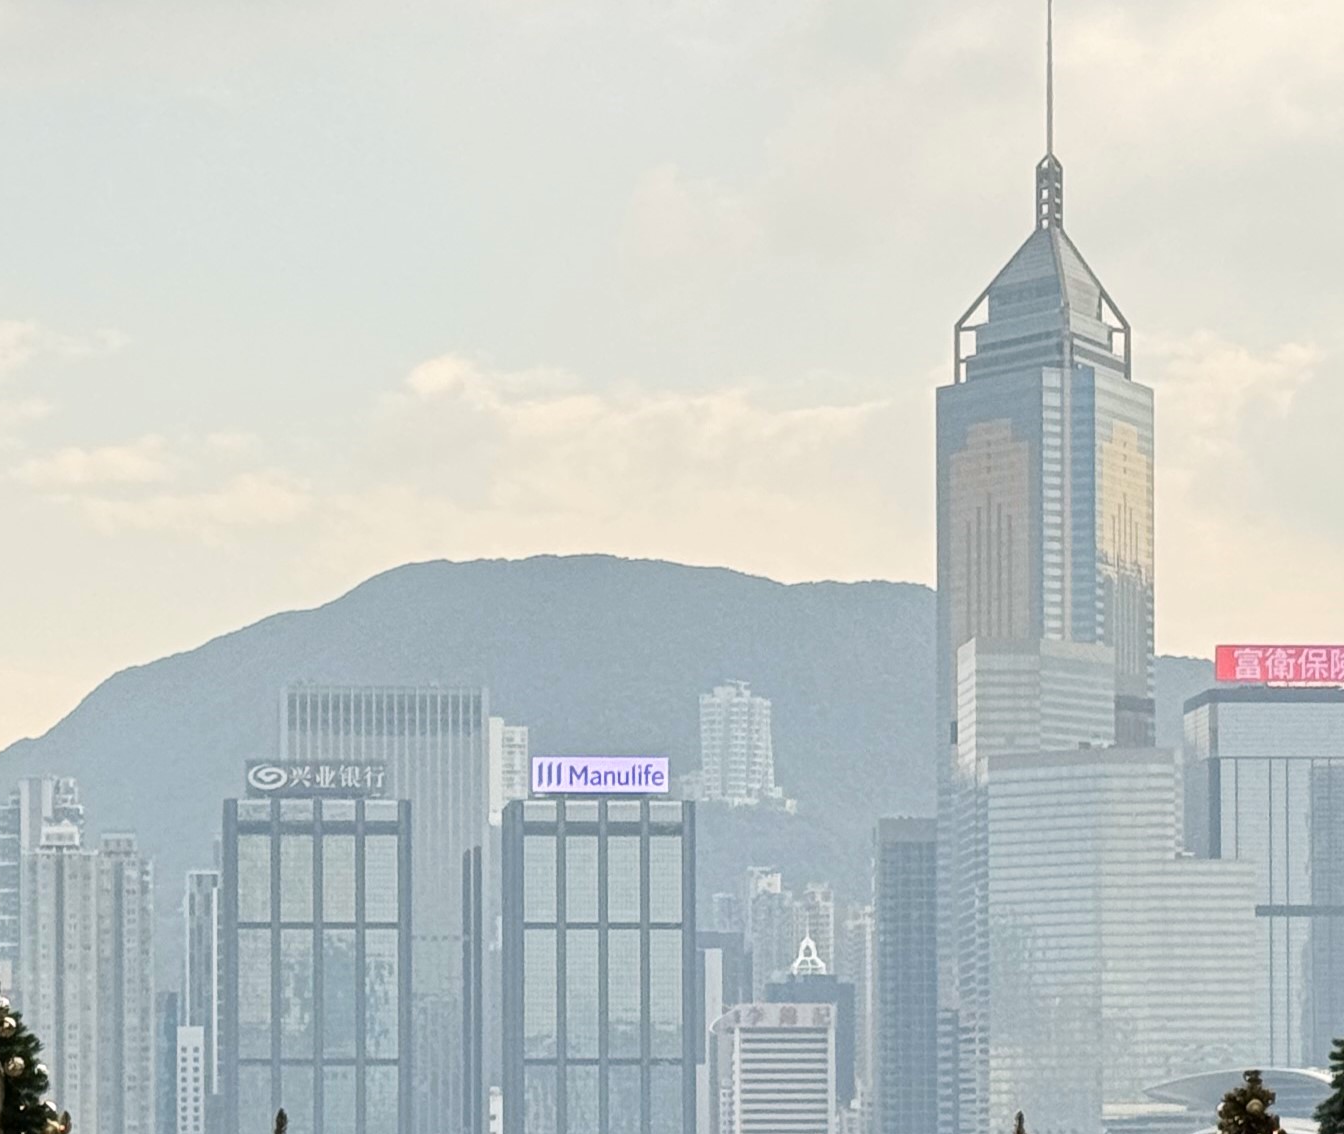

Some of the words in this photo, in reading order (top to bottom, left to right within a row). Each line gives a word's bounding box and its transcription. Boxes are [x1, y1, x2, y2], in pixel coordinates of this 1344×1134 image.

[289, 764, 385, 788] 兴业银行
[569, 763, 665, 787] Manulife
